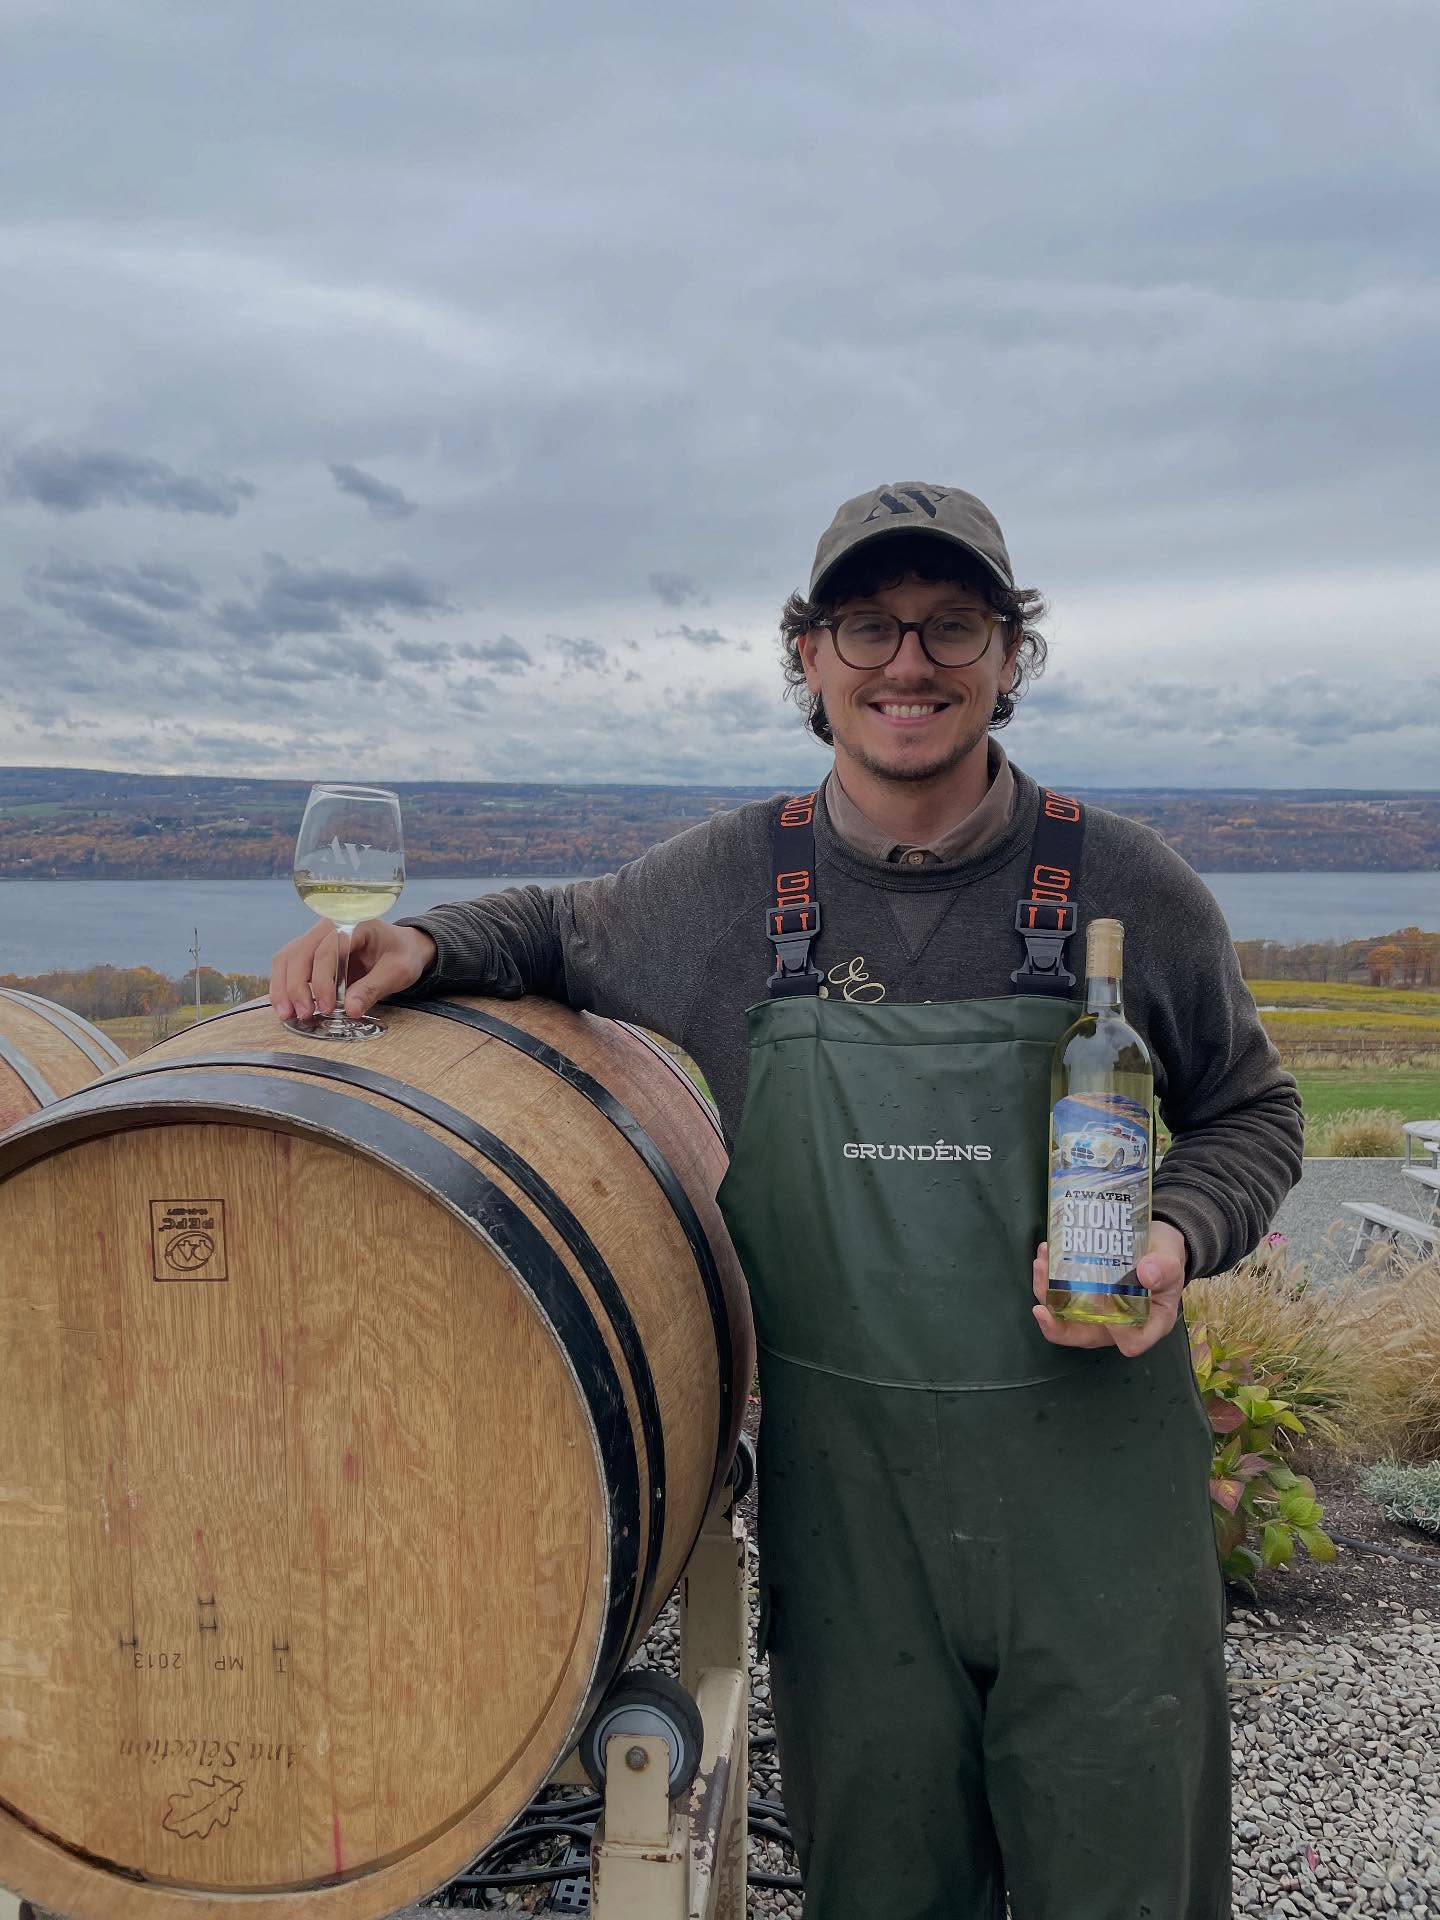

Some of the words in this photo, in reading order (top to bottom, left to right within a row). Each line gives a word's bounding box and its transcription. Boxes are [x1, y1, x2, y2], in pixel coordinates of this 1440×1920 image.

[843, 1138, 992, 1161] GRUNDÉNS
[1064, 1189, 1132, 1202] ATWATER
[1063, 1199, 1133, 1231] STONE
[1062, 1226, 1134, 1257] BRIDGE
[134, 1652, 182, 1670] 2013
[214, 1655, 244, 1671] MP
